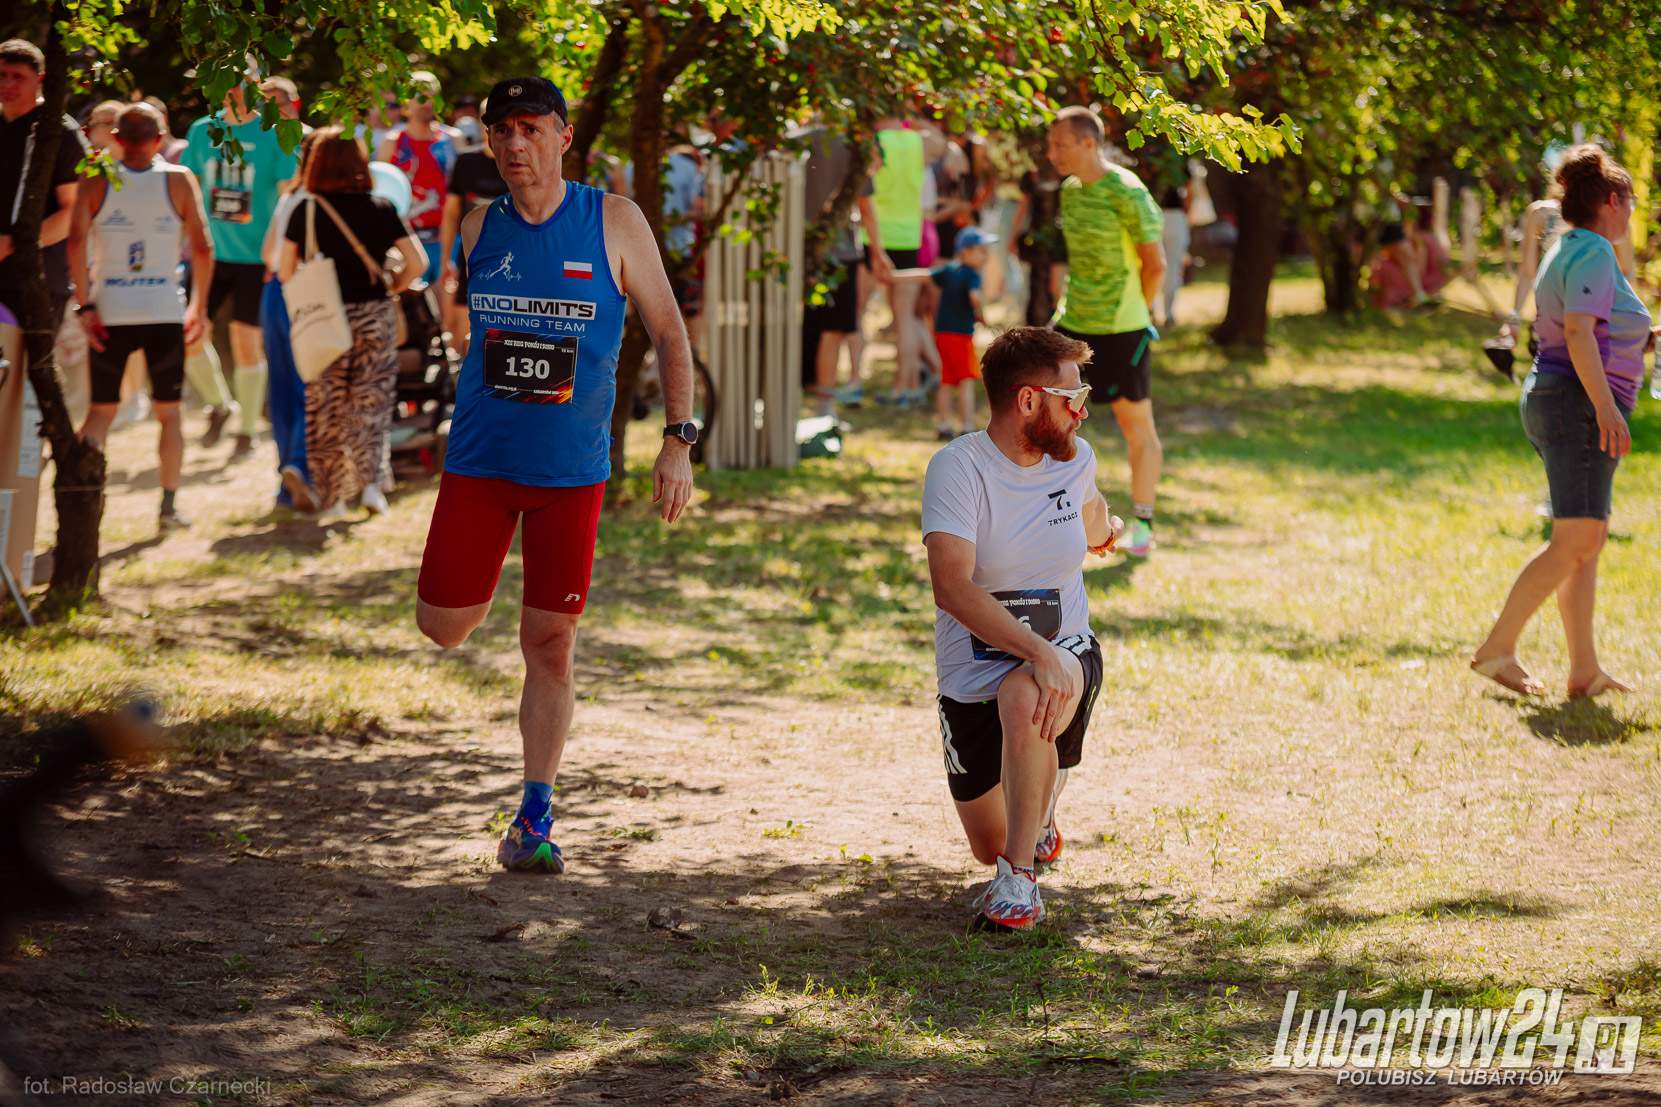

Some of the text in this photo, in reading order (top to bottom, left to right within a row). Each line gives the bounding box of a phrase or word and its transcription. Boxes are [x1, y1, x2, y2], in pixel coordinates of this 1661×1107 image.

[480, 314, 586, 332] RUNNING TEAM
[505, 356, 550, 380] 130
